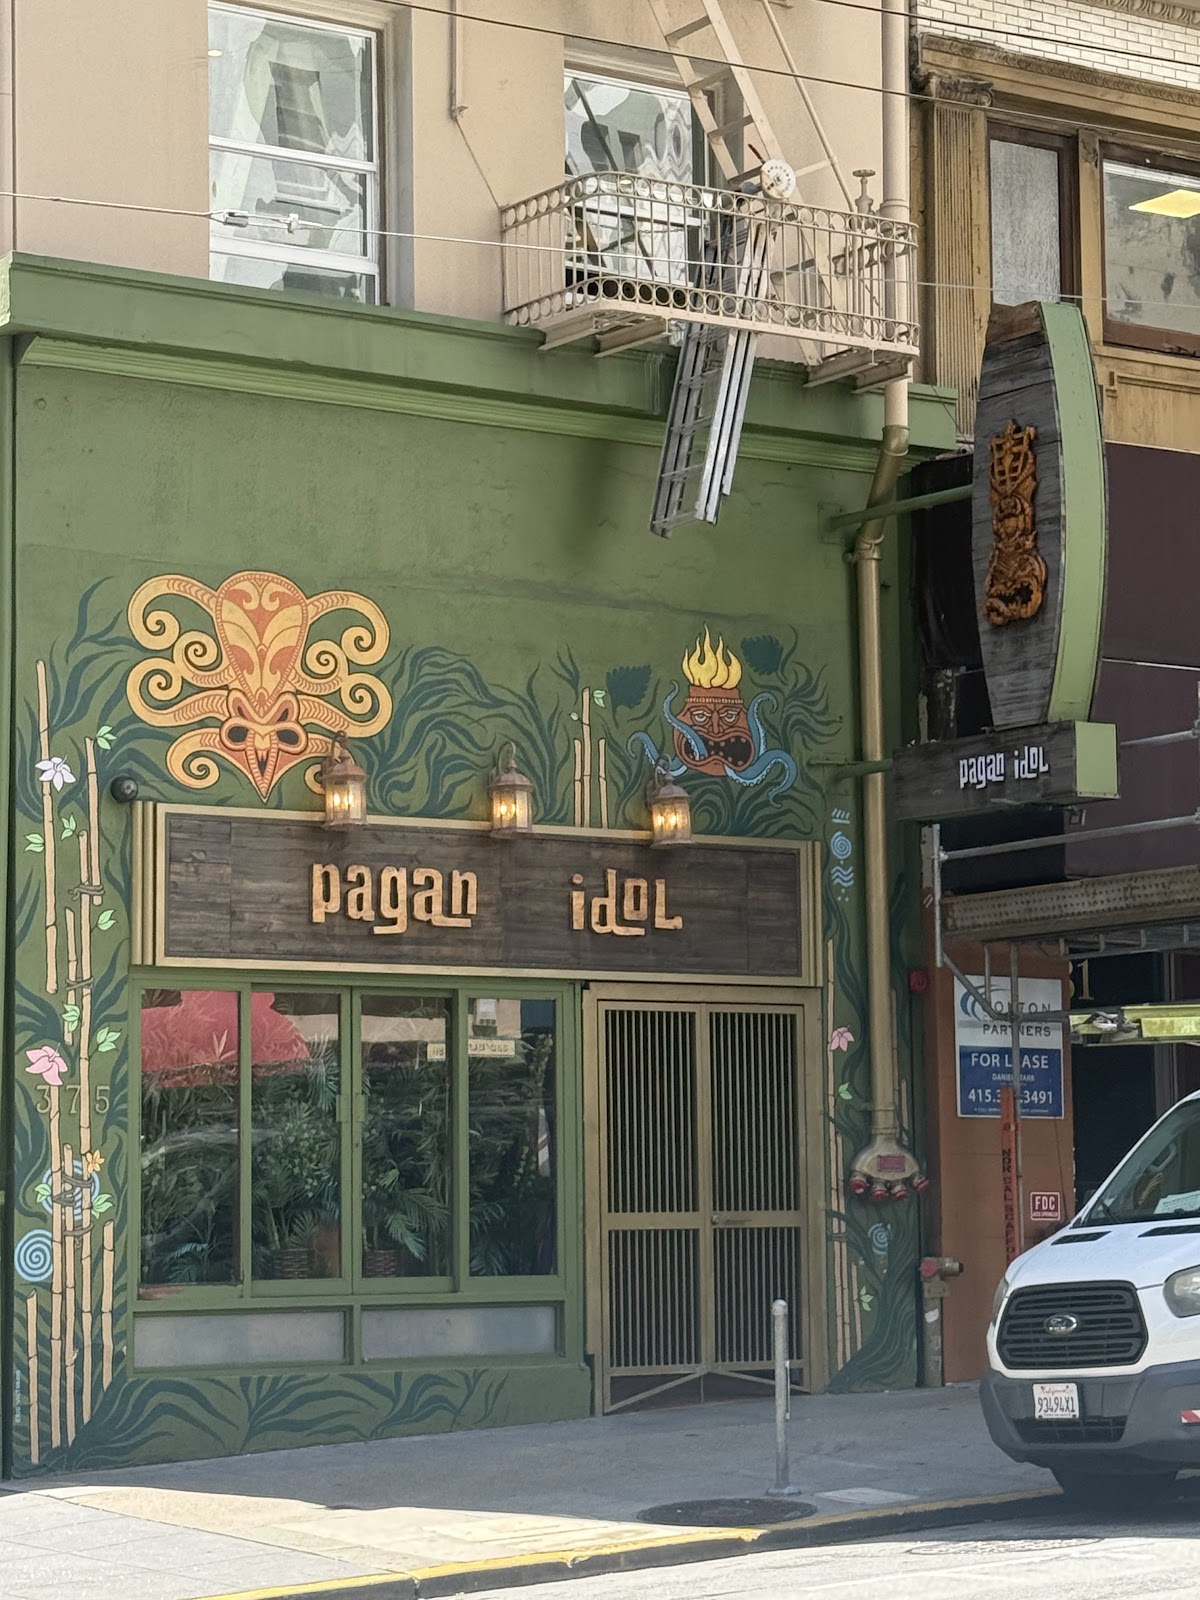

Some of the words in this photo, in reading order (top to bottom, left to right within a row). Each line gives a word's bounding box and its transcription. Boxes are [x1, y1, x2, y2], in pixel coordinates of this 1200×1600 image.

[959, 752, 1005, 790] pagan
[311, 862, 477, 935] pagan
[970, 1053, 1000, 1067] FOR
[1004, 1054, 1049, 1069] LASE
[36, 1085, 110, 1114] 375
[1035, 1195, 1056, 1210] FDC
[1037, 1396, 1076, 1413] 93494X1
